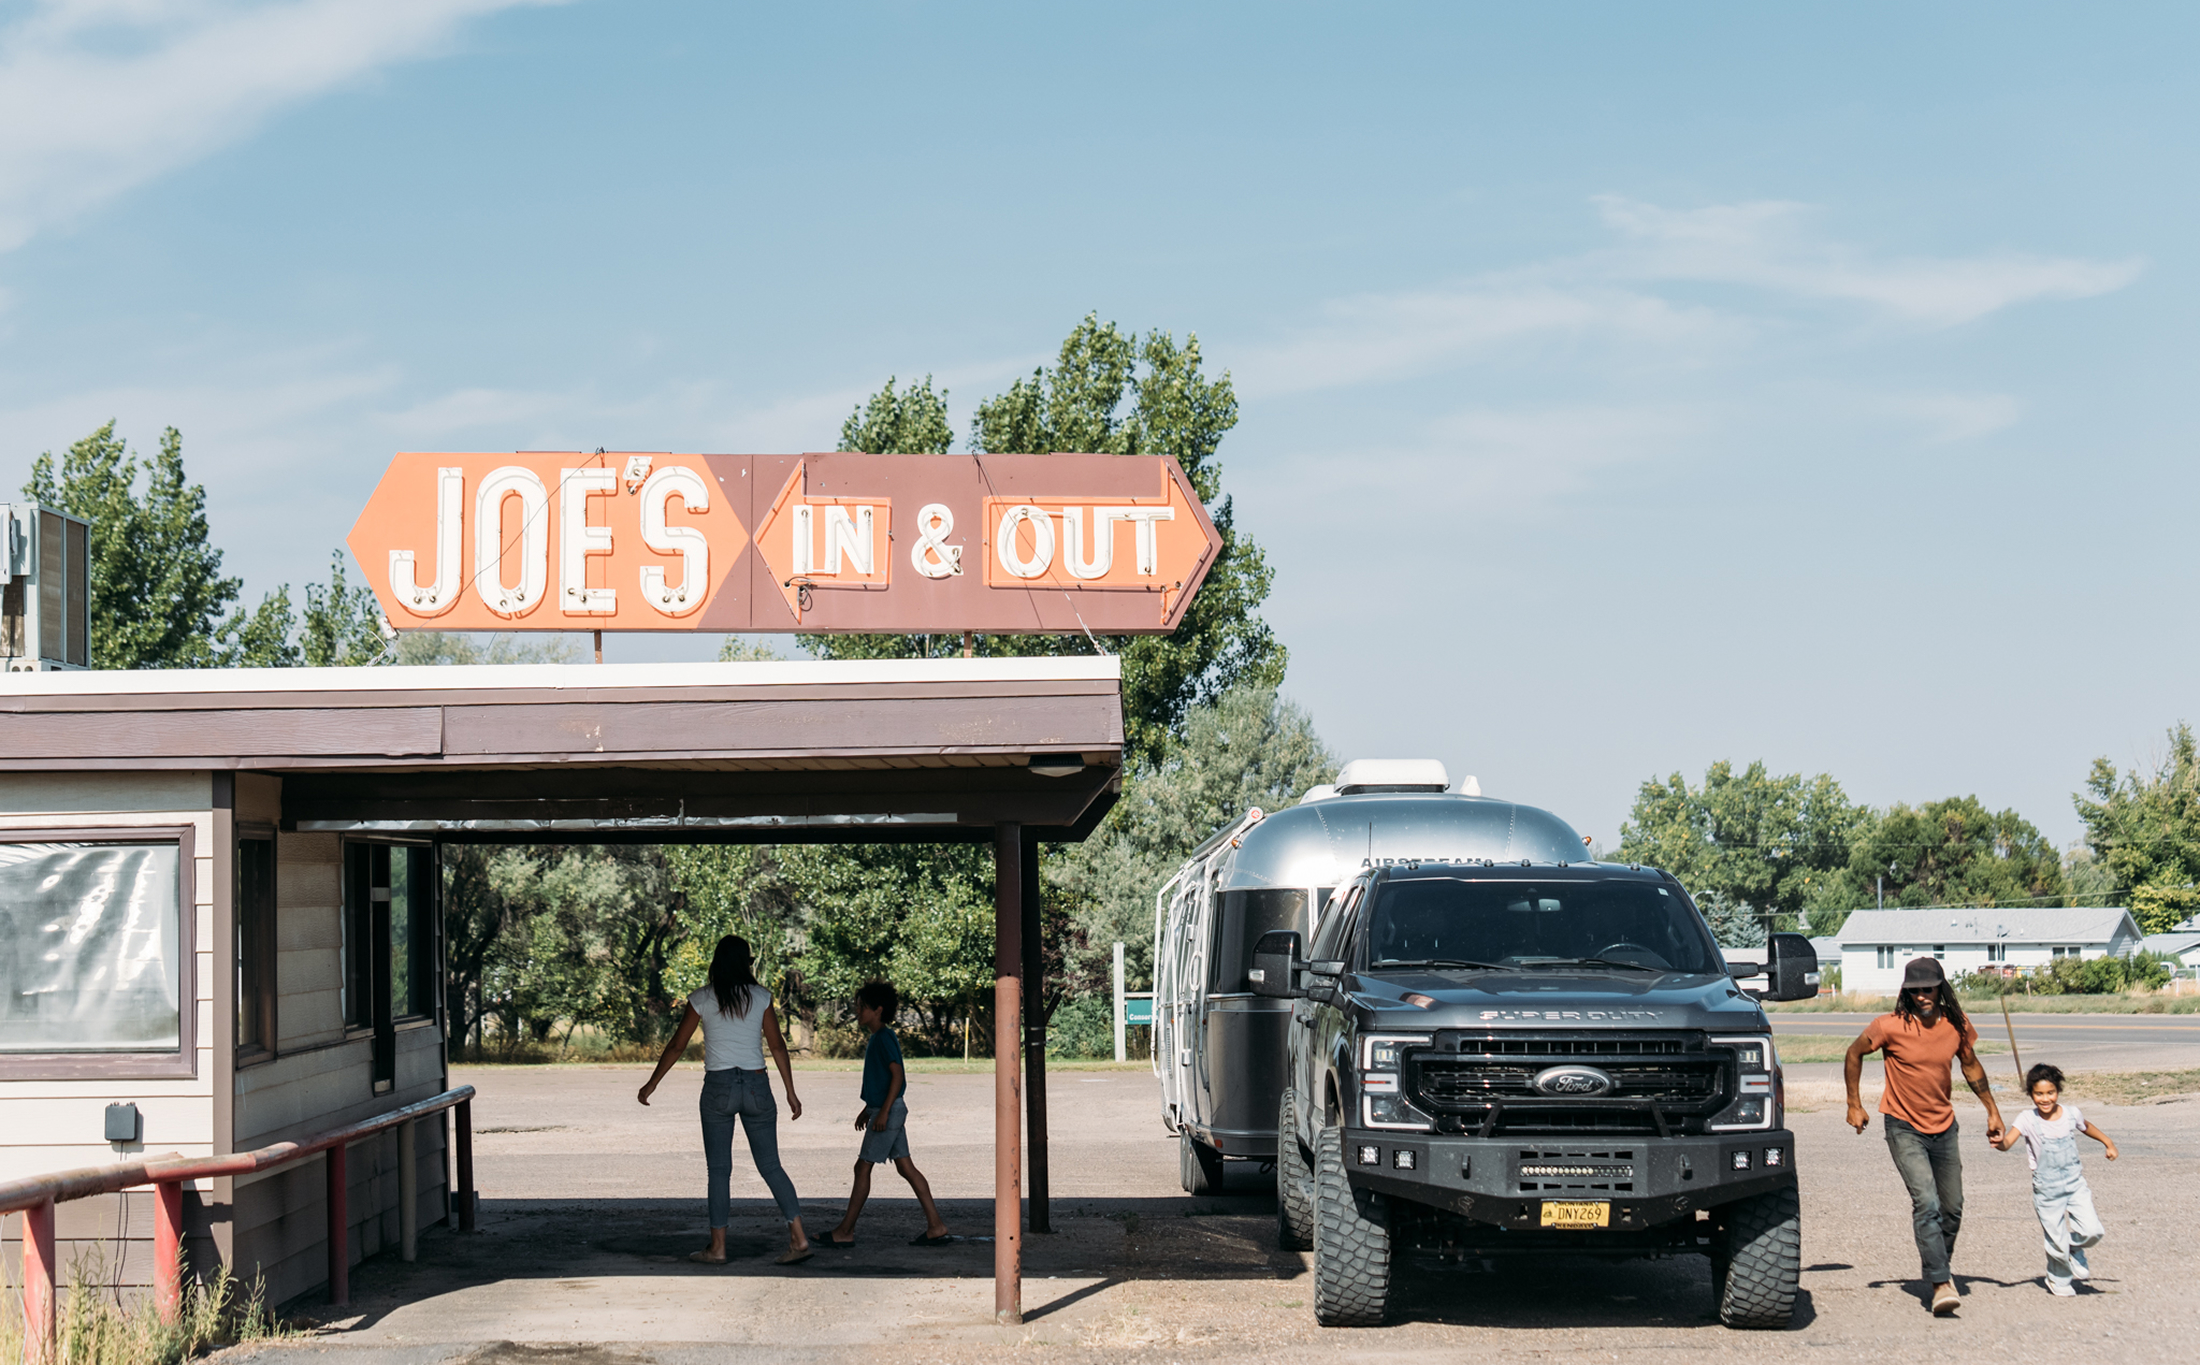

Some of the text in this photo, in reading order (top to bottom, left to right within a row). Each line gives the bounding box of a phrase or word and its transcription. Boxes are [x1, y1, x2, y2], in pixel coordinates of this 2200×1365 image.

[388, 455, 1176, 614] JOE'S IN & OUT
[1479, 1010, 1664, 1021] SUPER DUTY
[1555, 1075, 1593, 1092] Ford
[1558, 1207, 1602, 1220] DNY269
